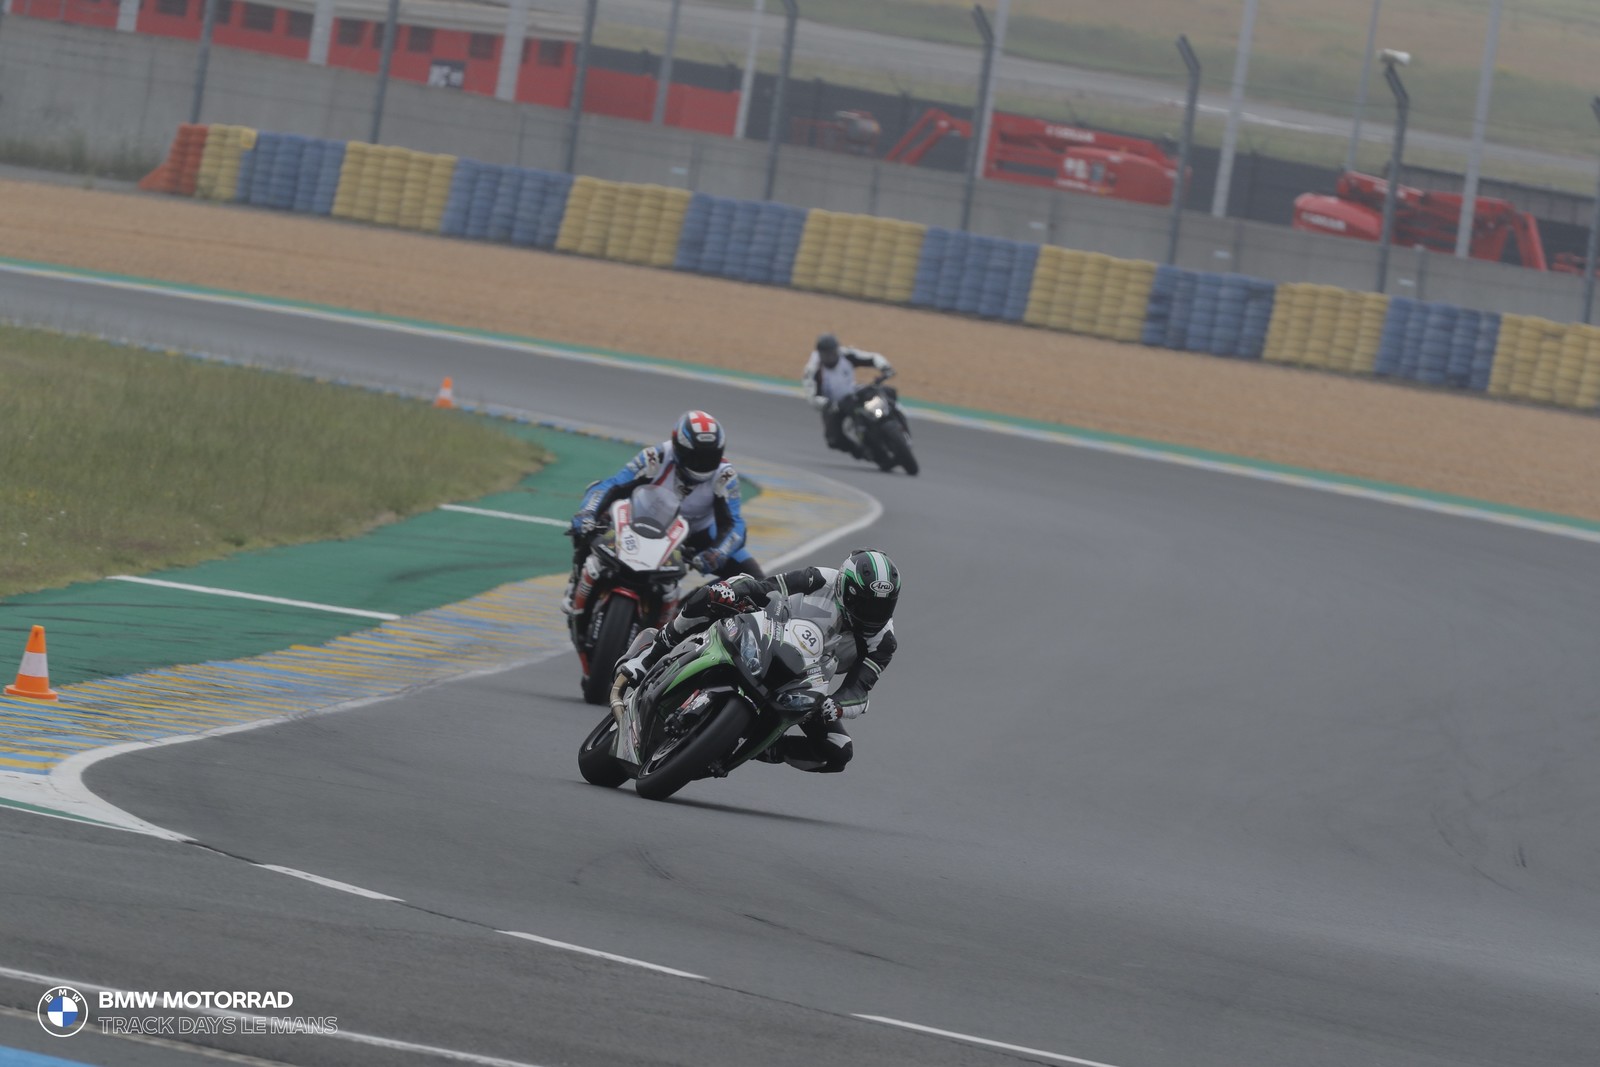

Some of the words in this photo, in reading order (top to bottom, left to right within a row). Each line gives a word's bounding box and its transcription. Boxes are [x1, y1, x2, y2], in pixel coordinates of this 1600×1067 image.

[623, 534, 637, 552] 185
[873, 581, 891, 591] Arai
[802, 629, 817, 648] 34
